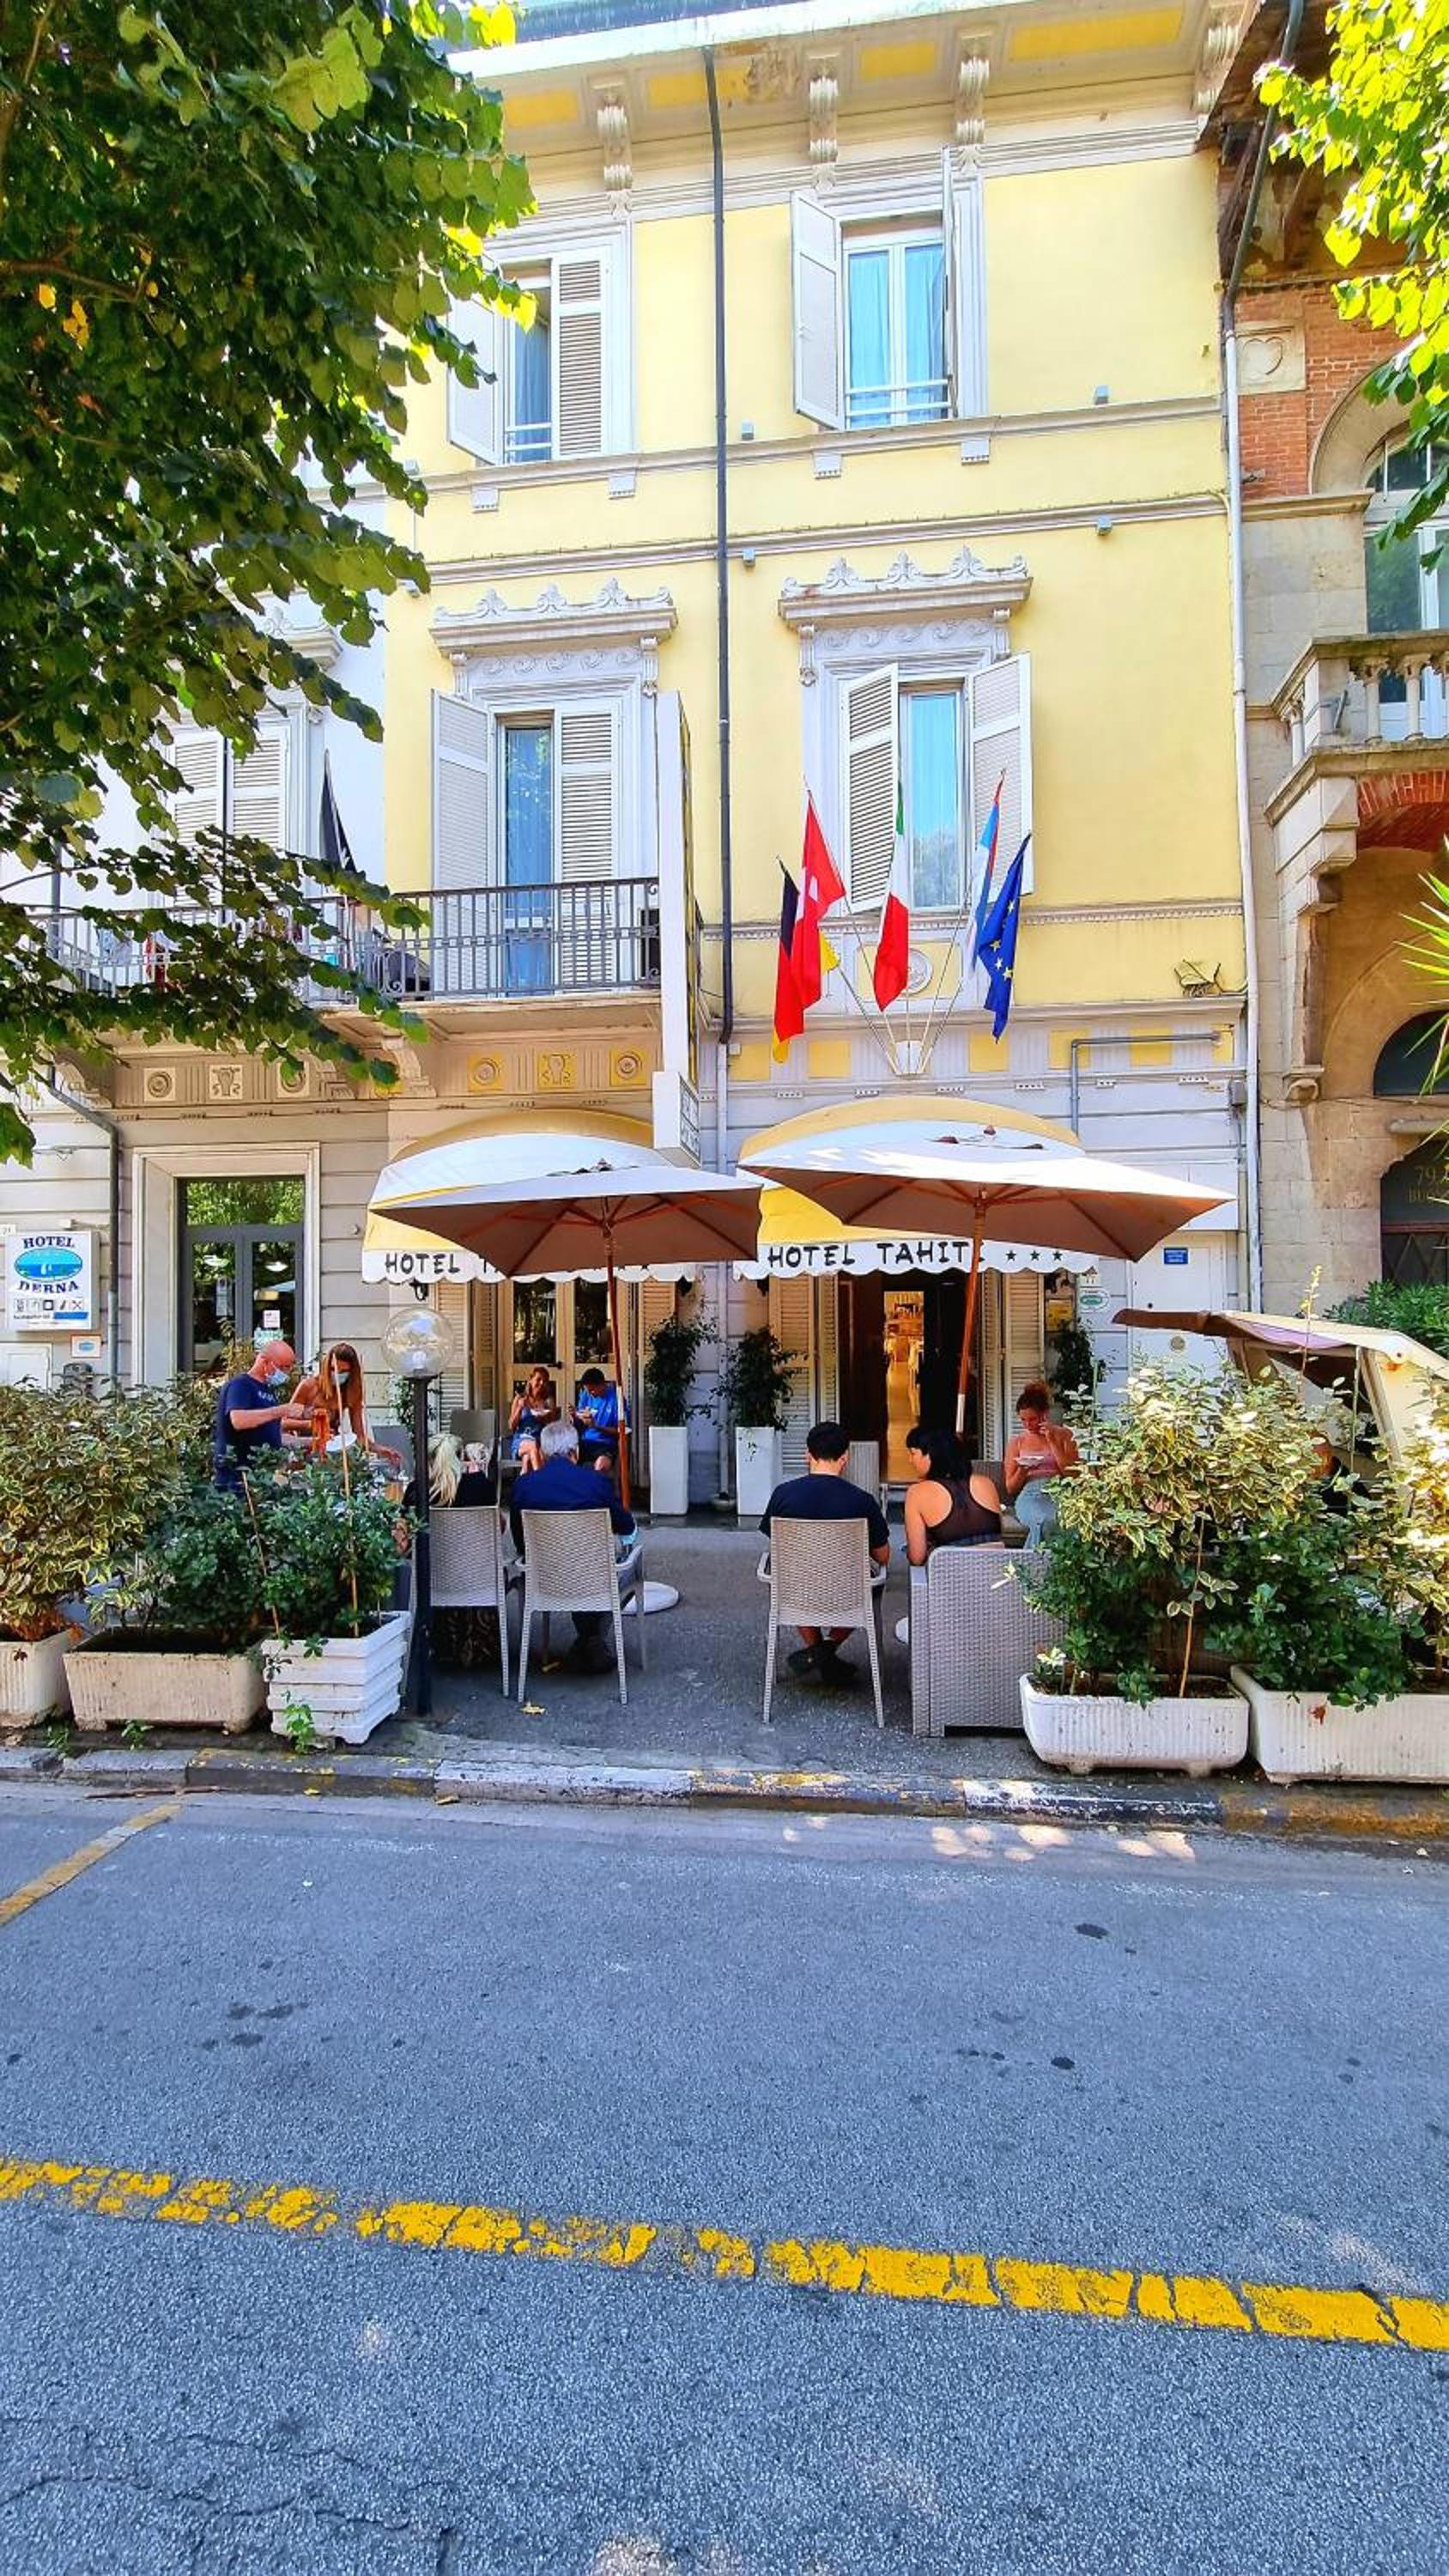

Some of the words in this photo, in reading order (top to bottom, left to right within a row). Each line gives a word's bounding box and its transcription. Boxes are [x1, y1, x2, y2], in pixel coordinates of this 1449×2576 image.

[23, 1236, 75, 1249] HOTEL
[385, 1253, 460, 1274] HOTEL
[768, 1244, 856, 1268] HOTEL
[18, 1280, 79, 1293] DERNA
